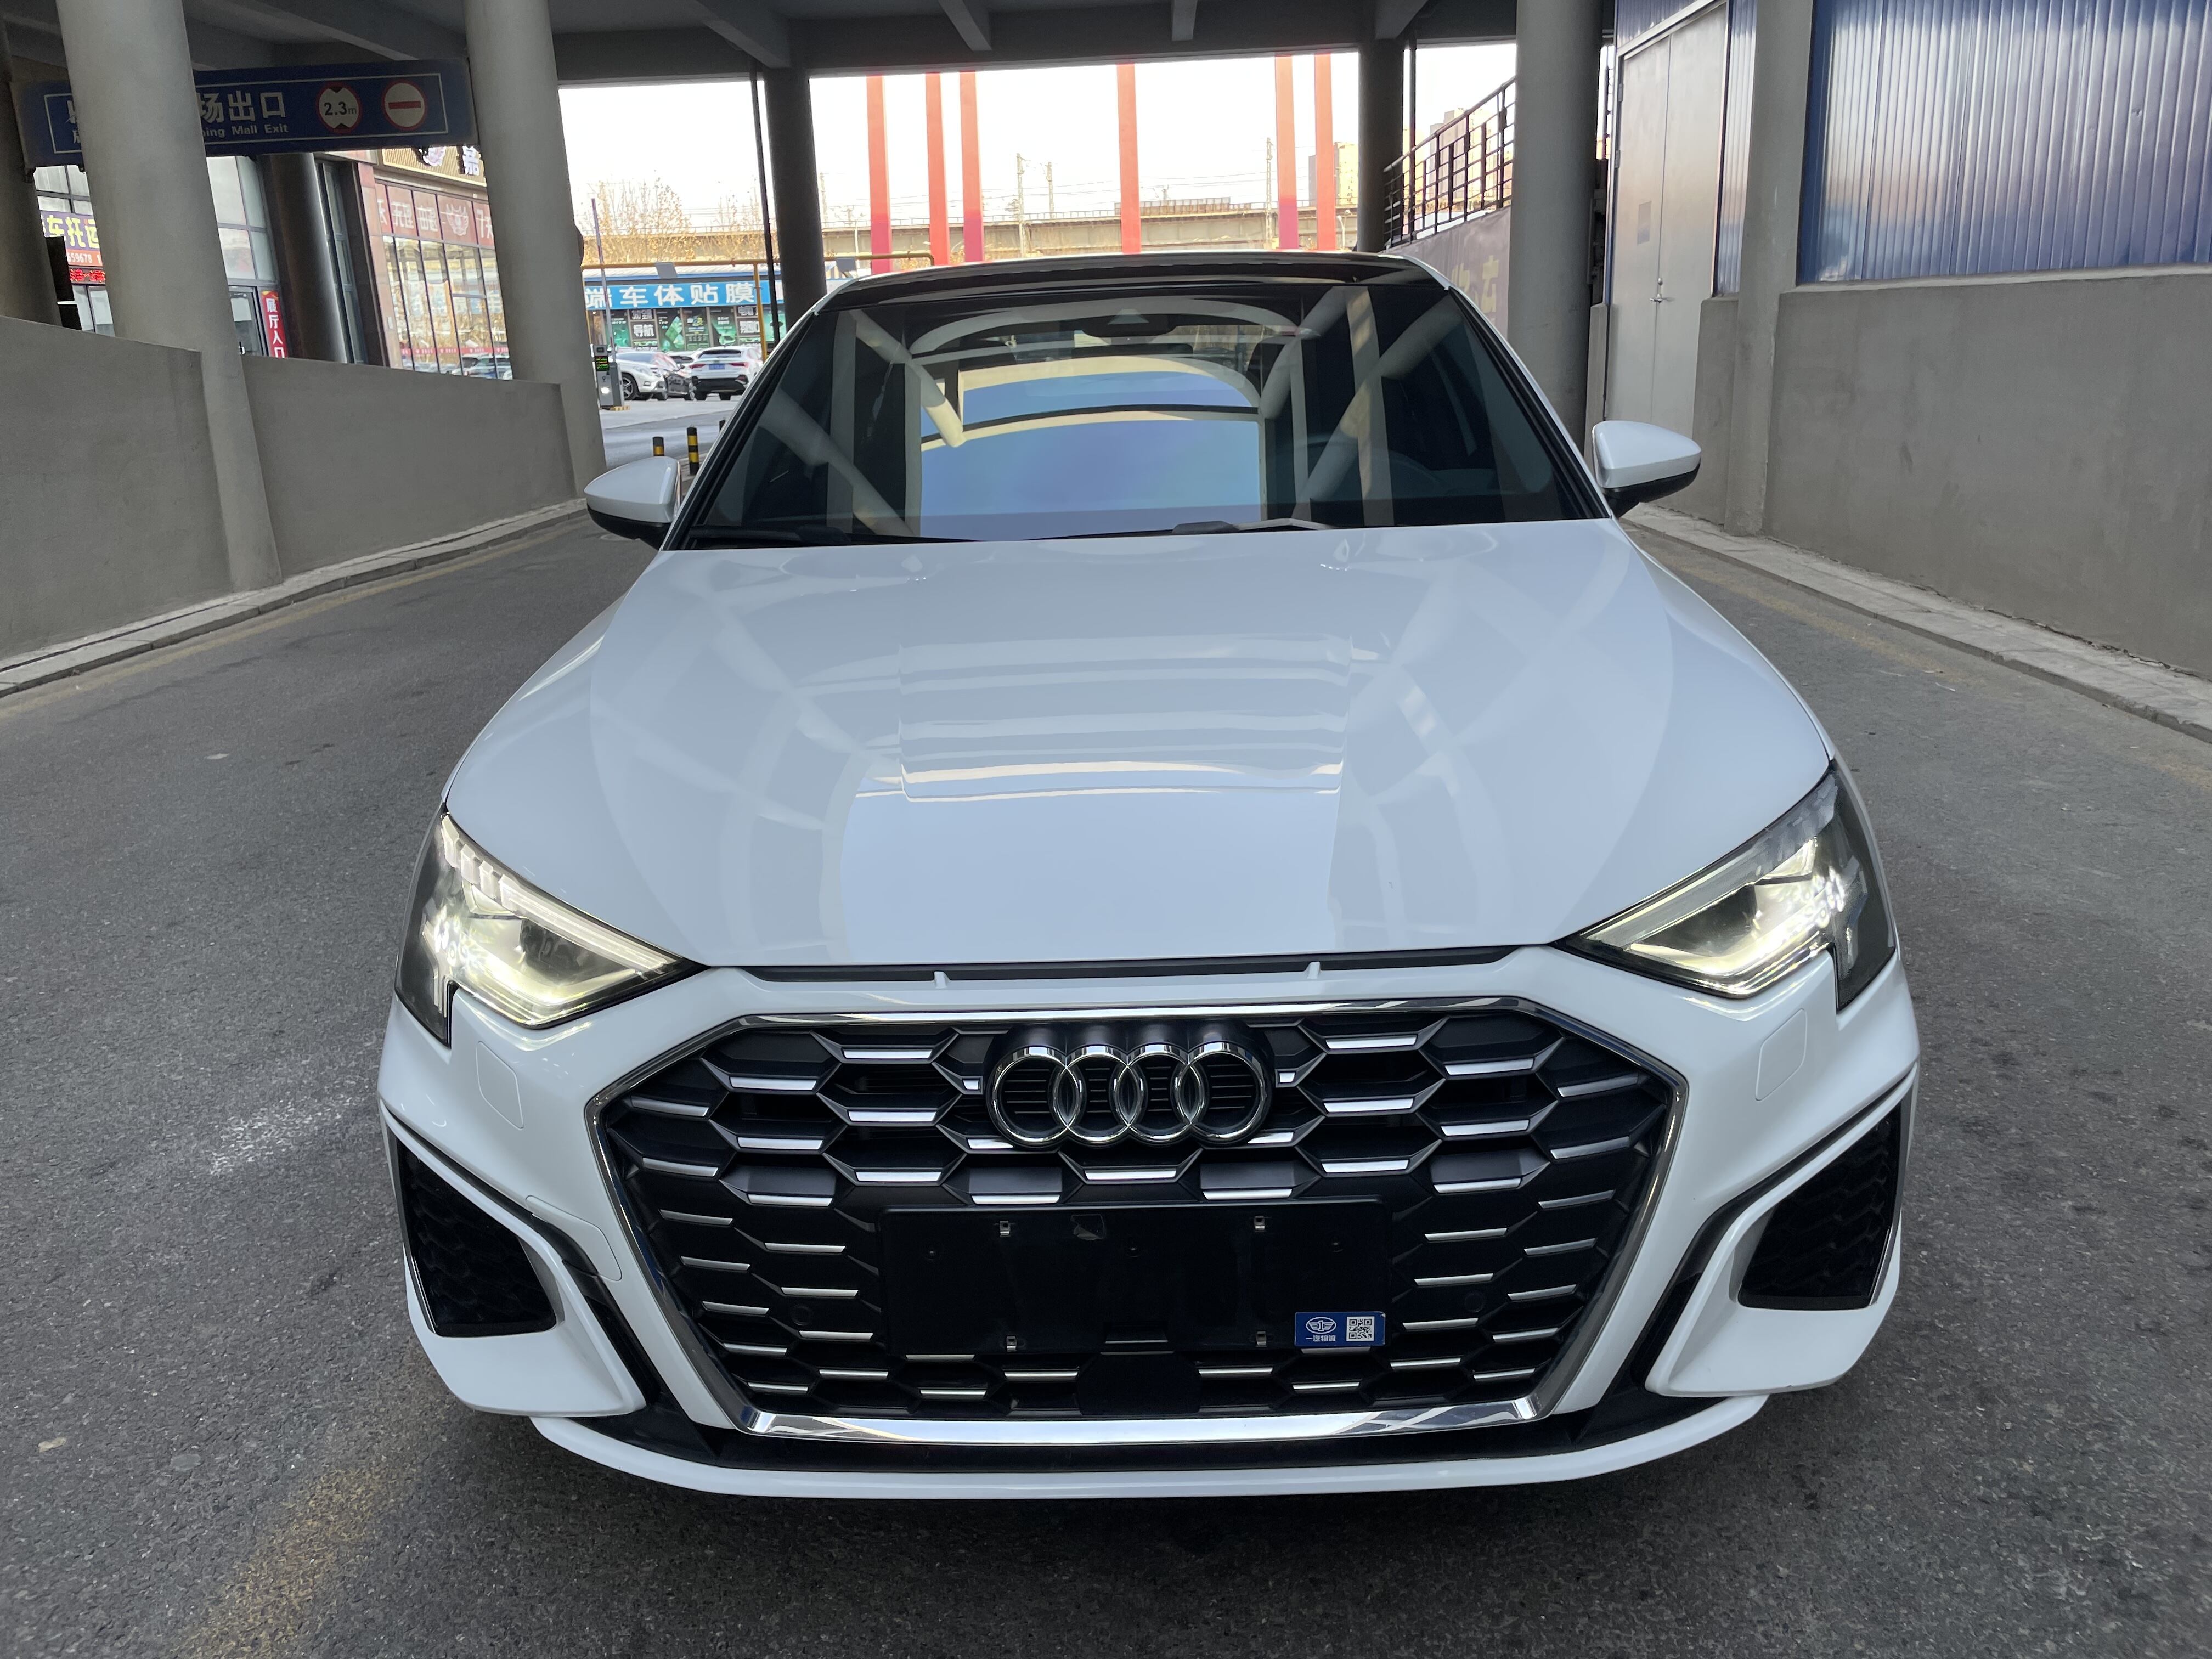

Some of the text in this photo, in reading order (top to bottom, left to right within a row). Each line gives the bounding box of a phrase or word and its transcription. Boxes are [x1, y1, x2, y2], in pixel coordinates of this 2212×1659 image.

[196, 90, 286, 123] 场出口
[232, 125, 257, 136] Mall
[264, 123, 289, 133] Exit
[41, 215, 100, 249] 车托运
[585, 282, 755, 308] 端车体贴膜
